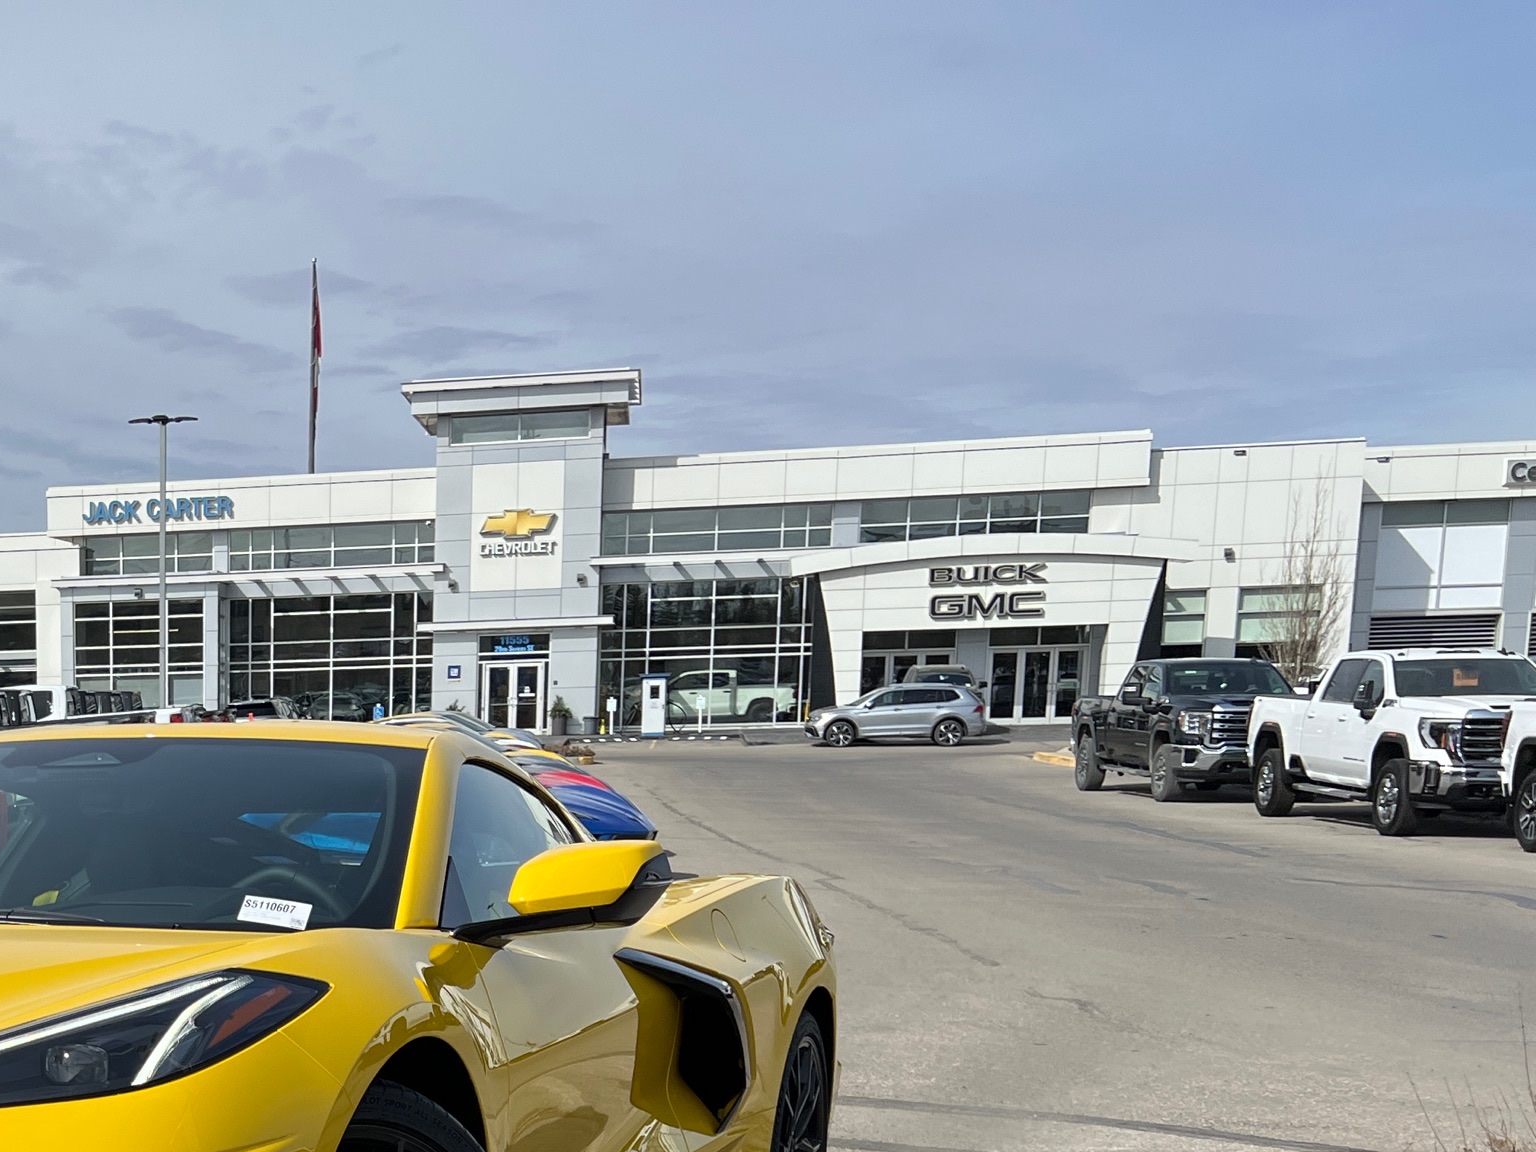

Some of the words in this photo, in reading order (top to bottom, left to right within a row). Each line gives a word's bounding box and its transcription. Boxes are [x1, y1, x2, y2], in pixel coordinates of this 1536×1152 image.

[82, 500, 141, 525] JACK
[146, 496, 234, 521] CARTER
[480, 542, 557, 558] CHEVROLET
[929, 563, 1049, 587] BUICK
[929, 590, 1046, 621] GMC
[244, 899, 296, 913] S5110607
[384, 1098, 413, 1112] SPORT
